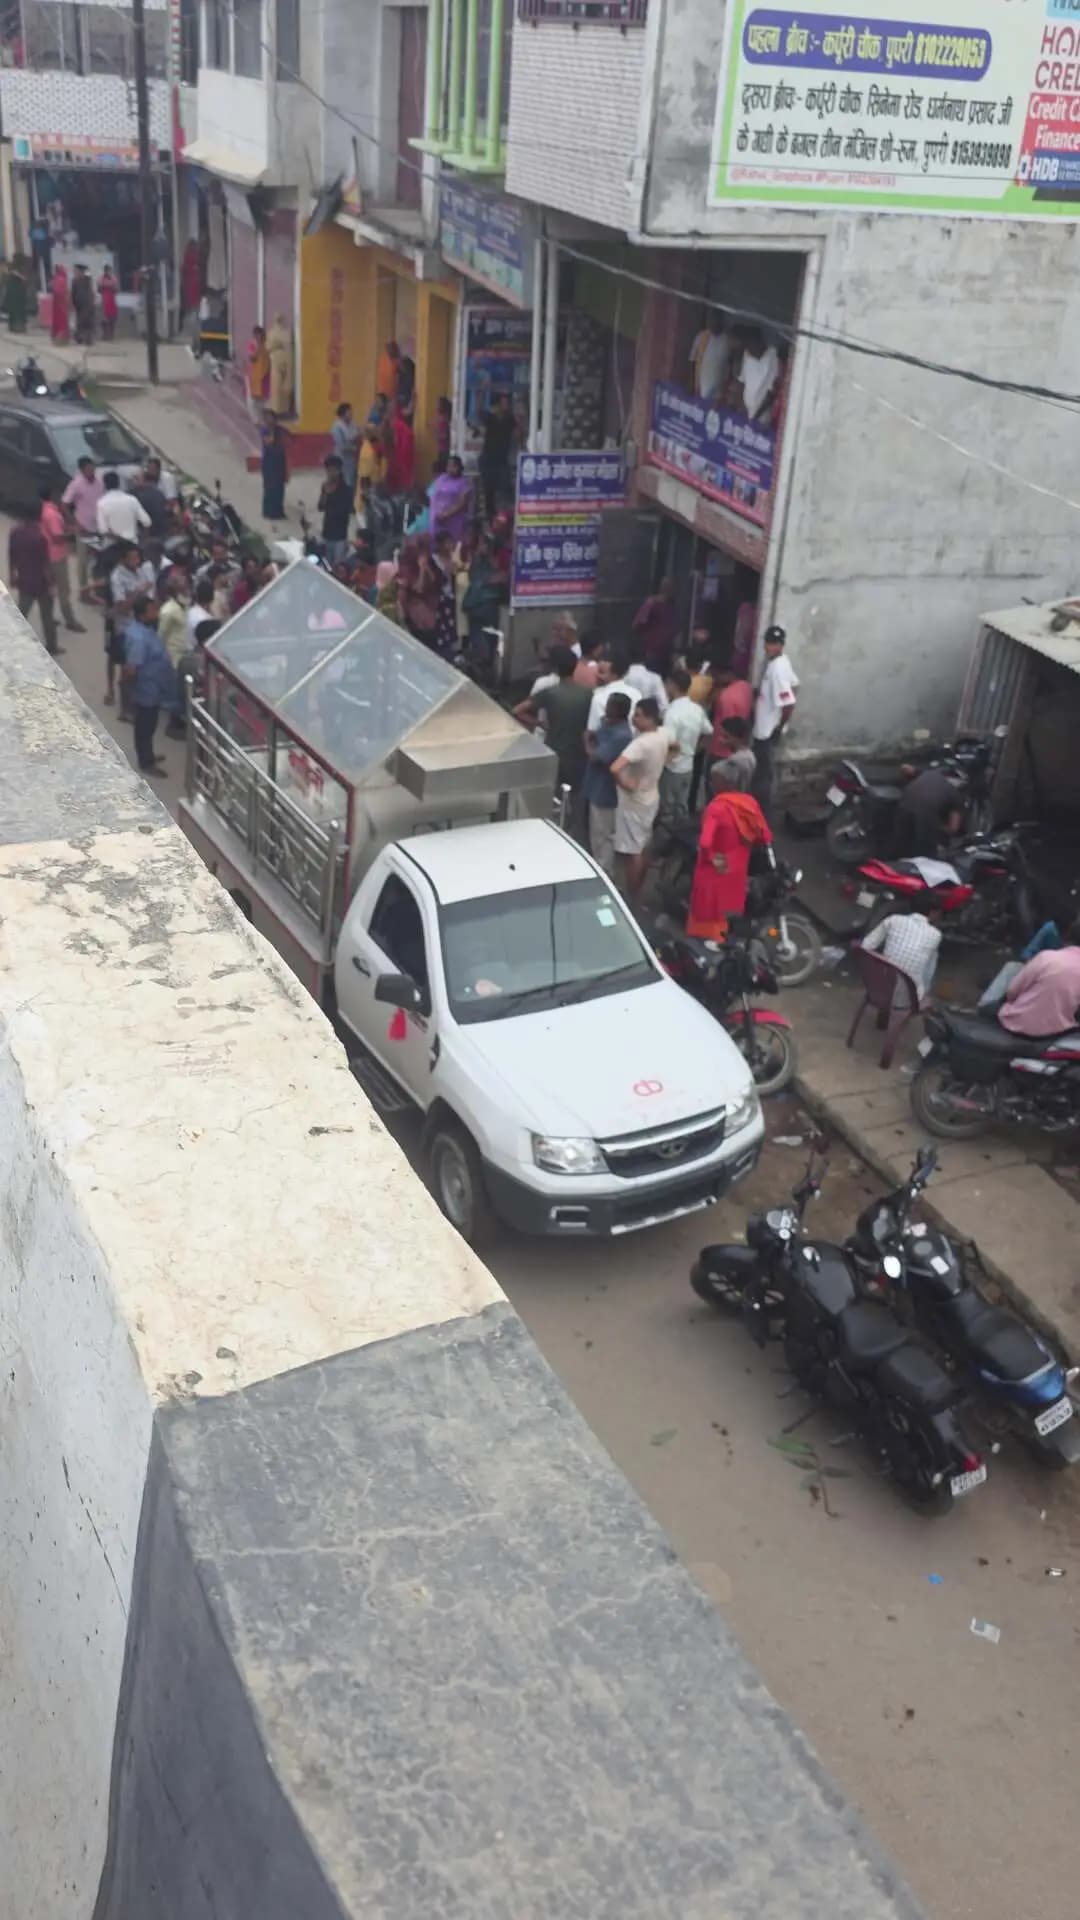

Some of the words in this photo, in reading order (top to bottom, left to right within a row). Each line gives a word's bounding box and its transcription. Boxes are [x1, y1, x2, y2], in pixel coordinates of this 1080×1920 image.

[748, 24, 782, 54] पहला
[742, 83, 773, 115] दूसरा
[998, 95, 1013, 126] जी
[1029, 95, 1067, 121] Credit
[736, 122, 750, 152] के
[775, 125, 789, 154] के
[1031, 157, 1060, 181] HDB
